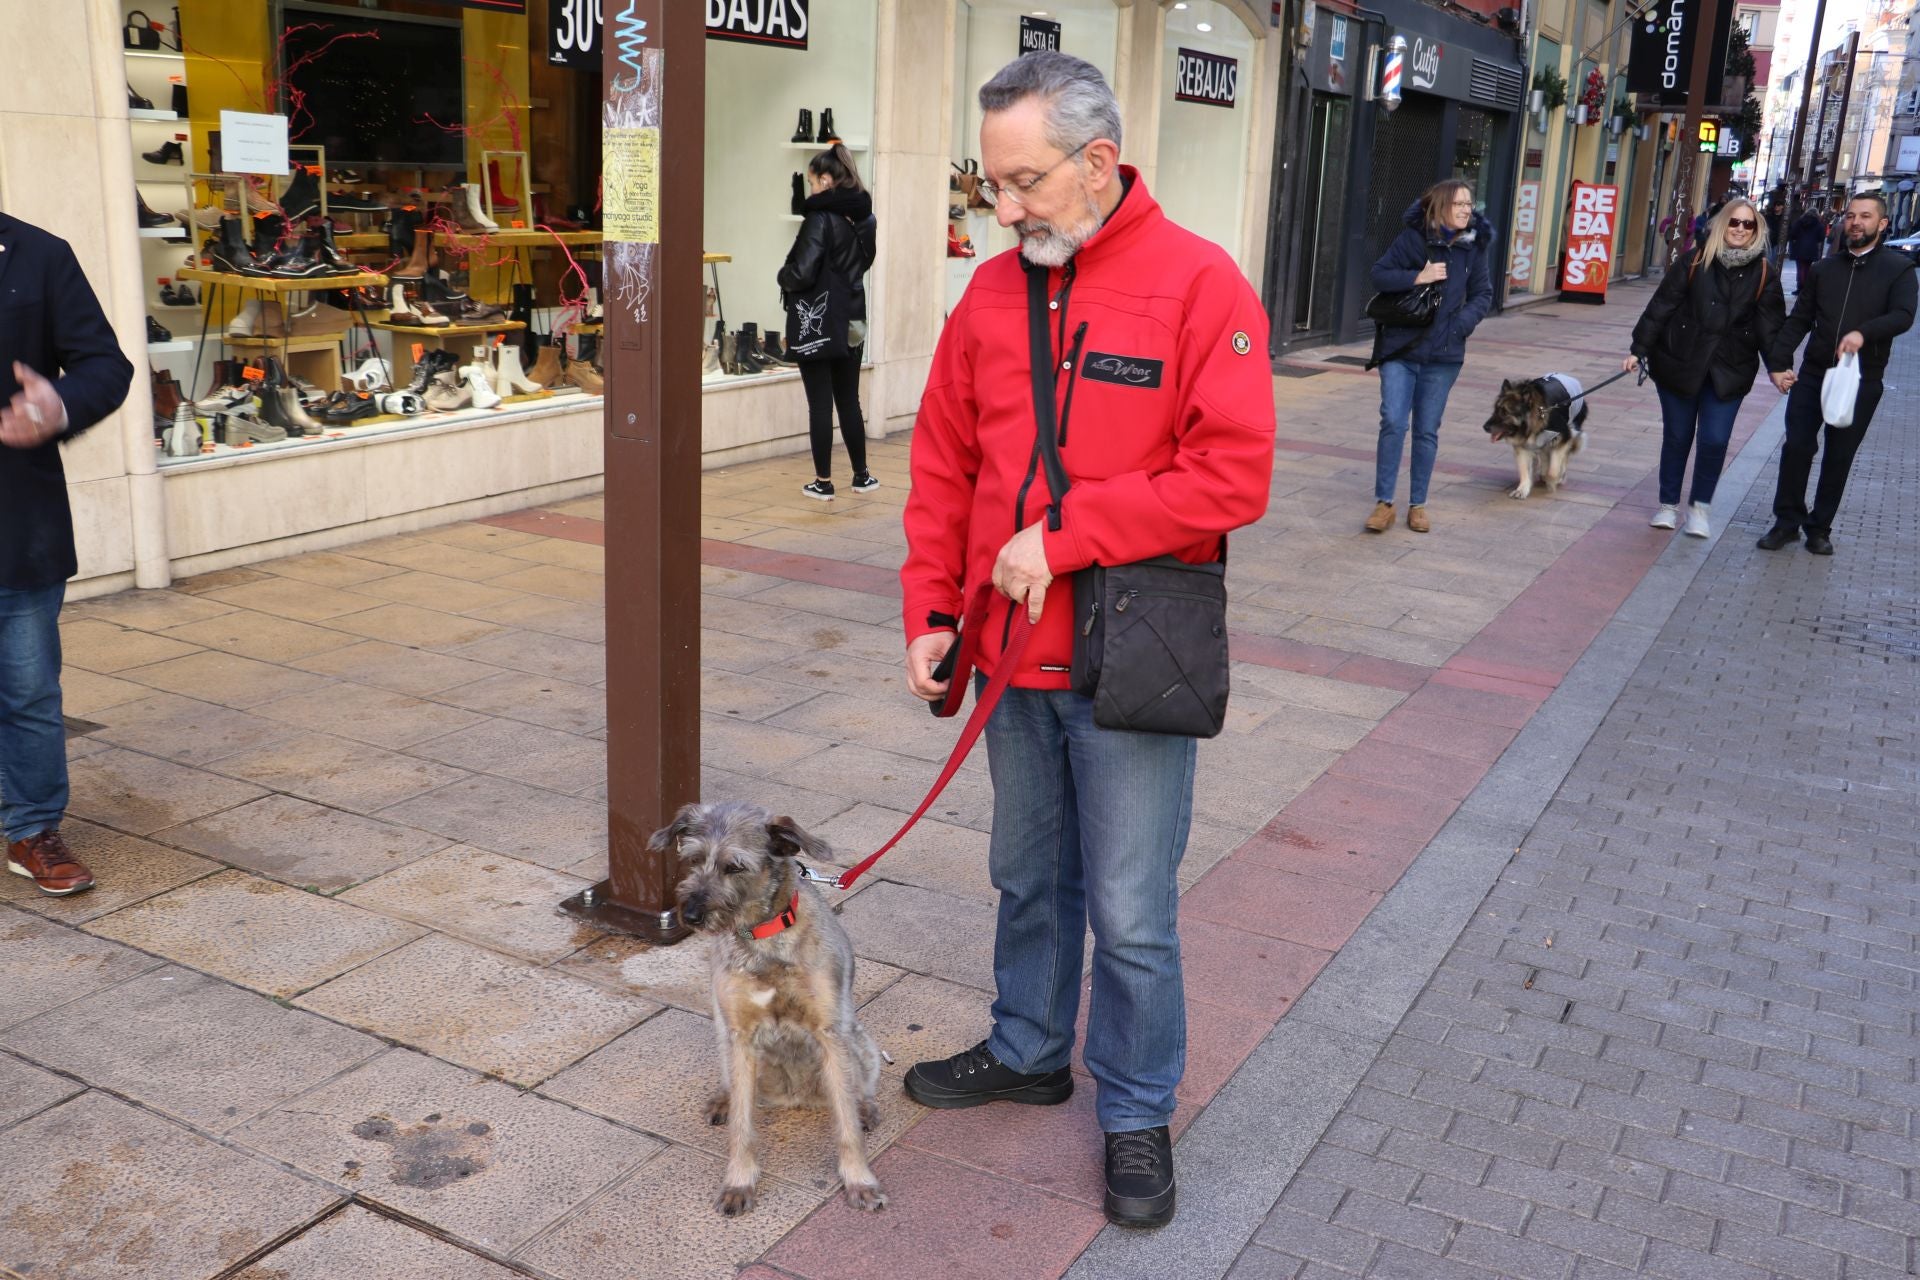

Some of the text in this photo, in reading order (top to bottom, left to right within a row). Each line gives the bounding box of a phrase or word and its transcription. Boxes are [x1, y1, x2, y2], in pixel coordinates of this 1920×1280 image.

[556, 0, 603, 52] 30
[1023, 29, 1056, 51] HASTA EL
[1412, 37, 1439, 88] Cutfy
[1176, 55, 1236, 101] REBAJAS
[1575, 187, 1616, 213] RE
[1572, 212, 1610, 236] BA
[1568, 243, 1608, 262] JA
[1565, 260, 1586, 285] S
